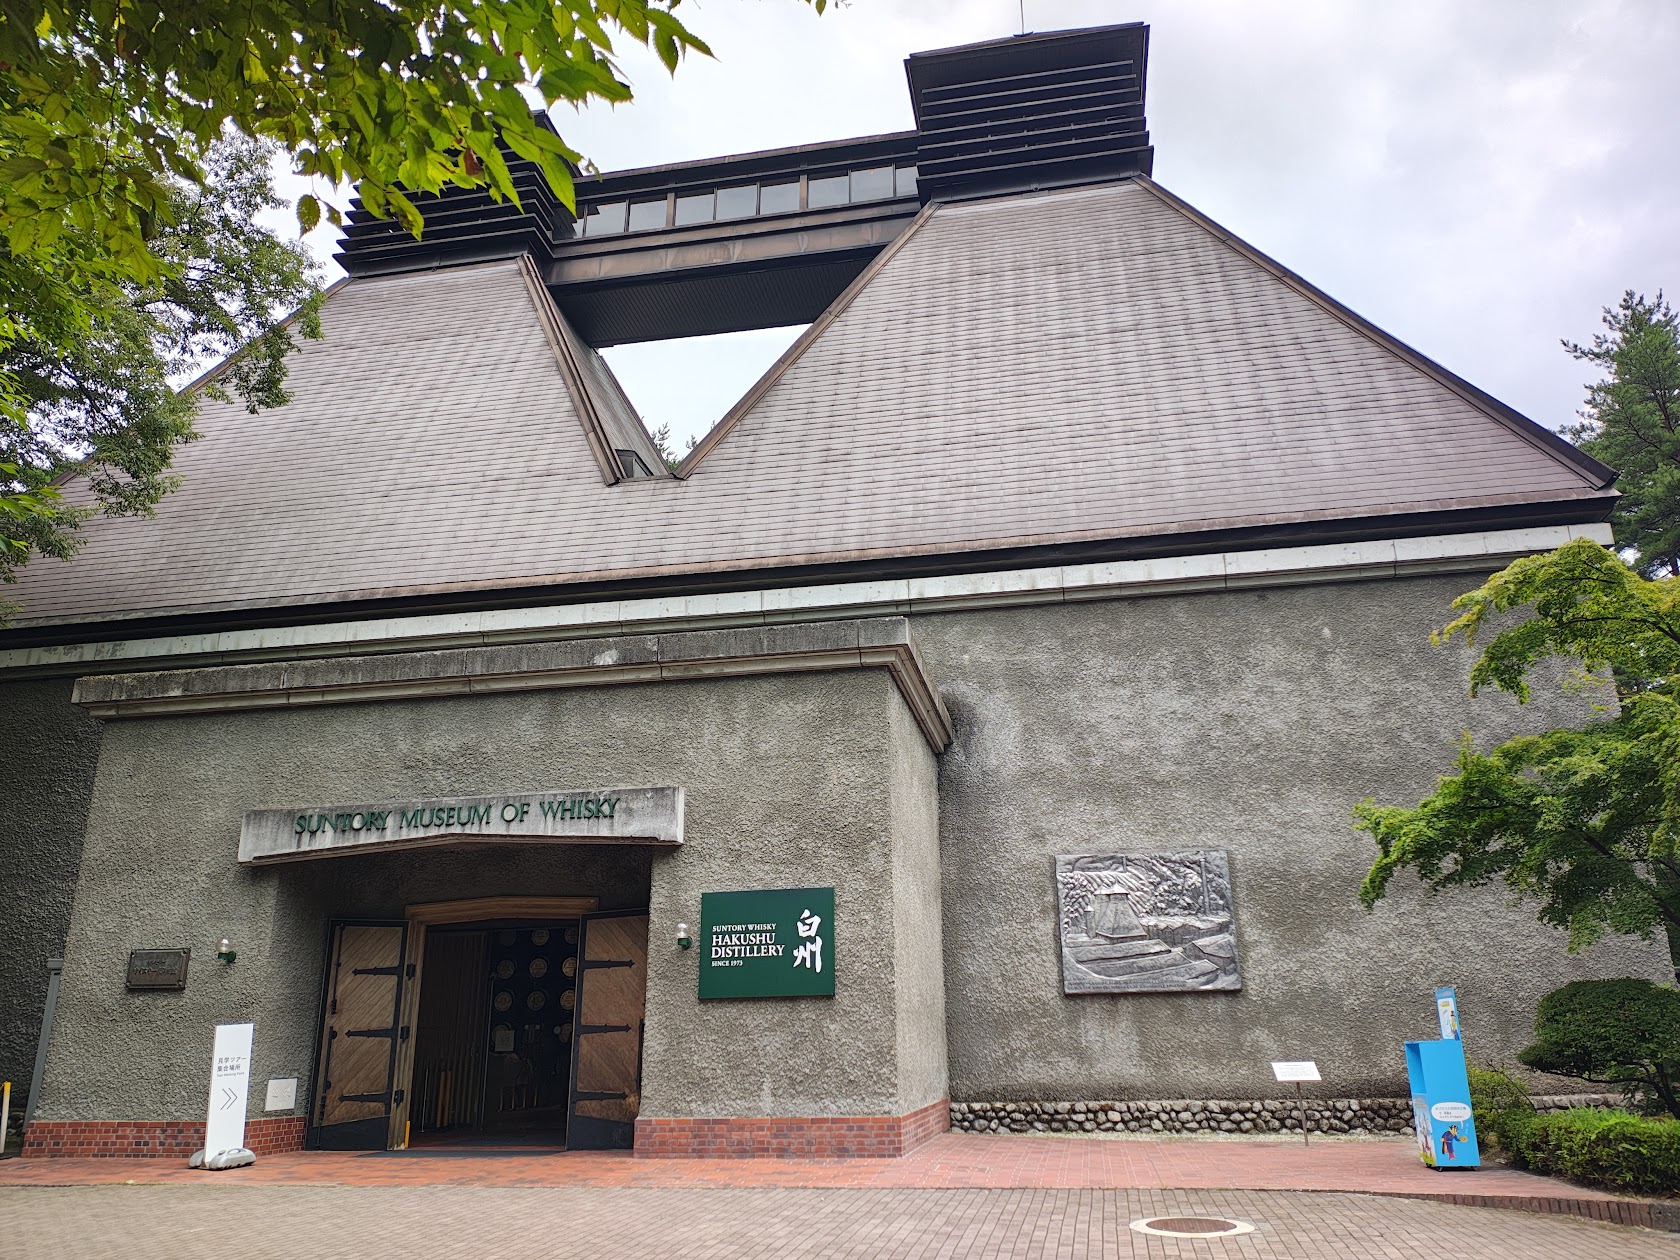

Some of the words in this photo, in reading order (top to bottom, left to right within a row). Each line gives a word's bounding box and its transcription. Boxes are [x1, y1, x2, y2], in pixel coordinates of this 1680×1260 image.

[294, 810, 392, 834] SUNTORY
[400, 803, 492, 827] MUSEUM
[501, 803, 530, 823] OF
[540, 798, 620, 820] WHISKY
[712, 924, 746, 932] SUNTORY
[747, 923, 777, 931] WHISKY
[712, 932, 776, 946] HAKUSHU
[793, 909, 822, 973] 白州
[711, 945, 785, 958] DISTILLERY
[217, 1056, 247, 1064] 見学ツアー
[217, 1064, 241, 1072] 集合場所
